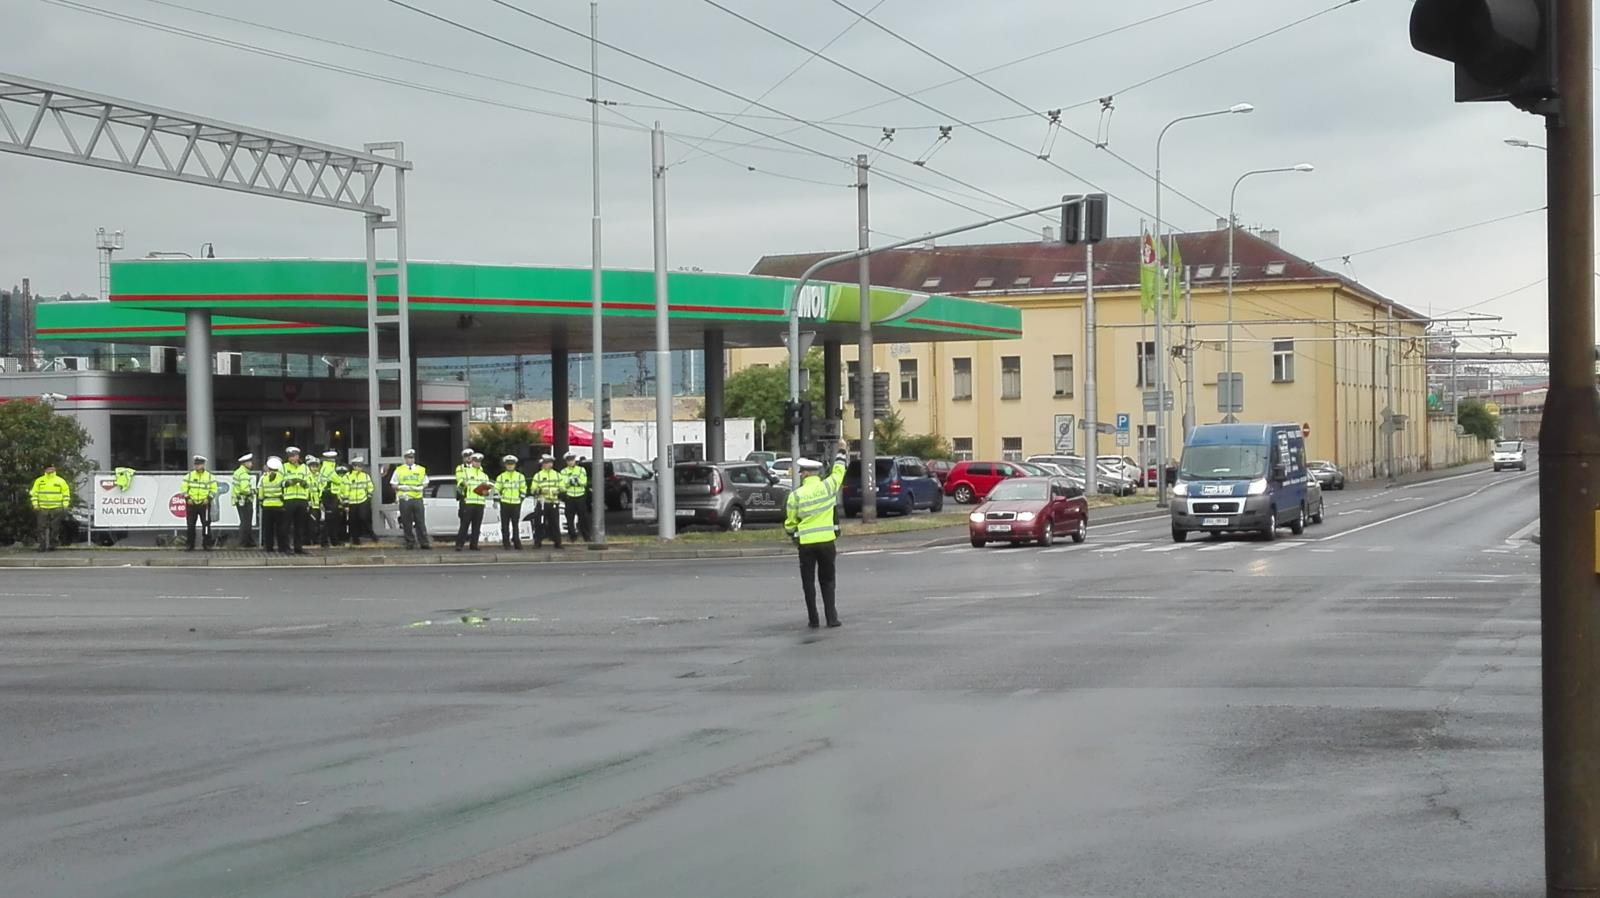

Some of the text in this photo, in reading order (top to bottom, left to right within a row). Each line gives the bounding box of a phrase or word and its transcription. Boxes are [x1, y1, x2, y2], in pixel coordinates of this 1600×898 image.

[797, 284, 826, 319] MOL
[102, 507, 147, 515] NA KUTILY
